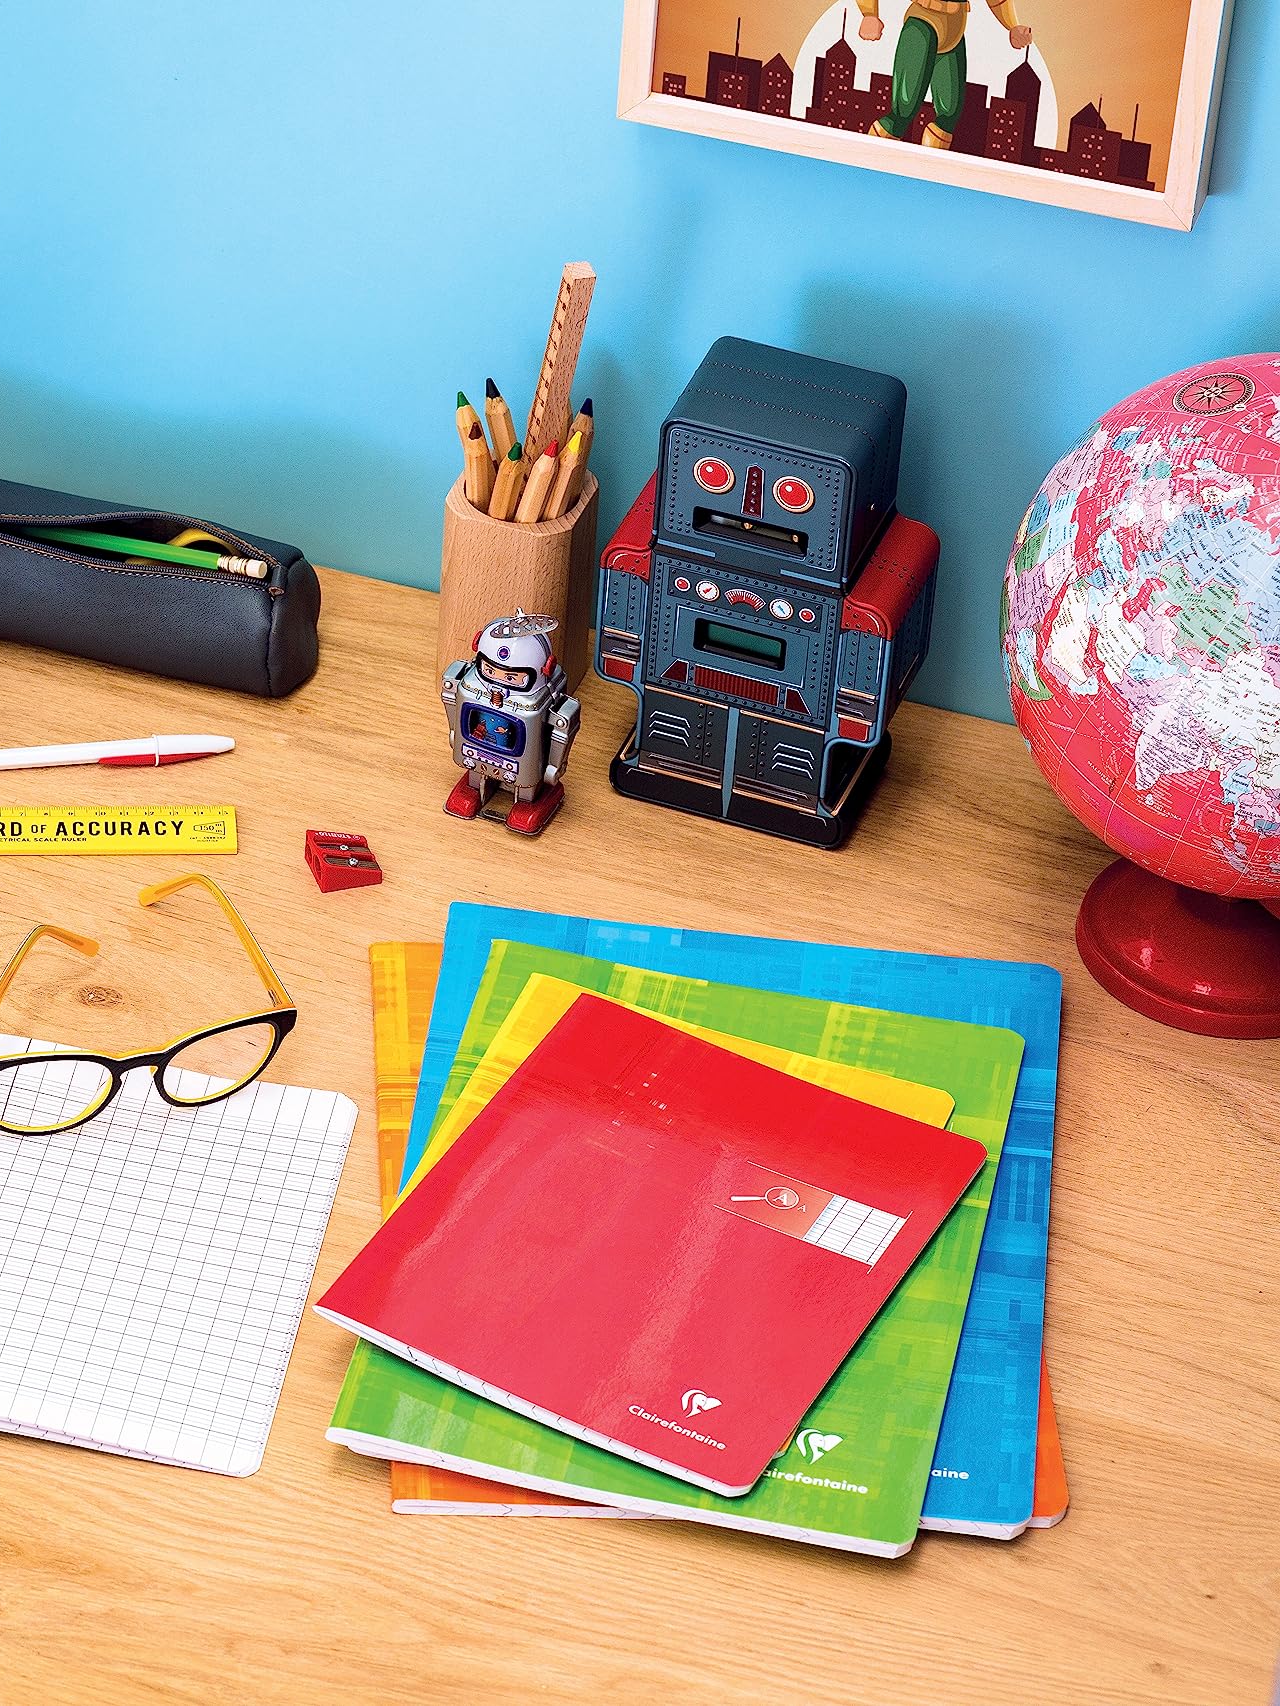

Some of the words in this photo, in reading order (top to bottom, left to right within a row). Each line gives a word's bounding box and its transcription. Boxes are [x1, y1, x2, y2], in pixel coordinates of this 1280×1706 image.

[31, 824, 47, 834] OF
[55, 821, 184, 836] ACCURACY
[628, 1403, 726, 1451] Clairefontaine
[764, 1469, 868, 1494] airefontaine
